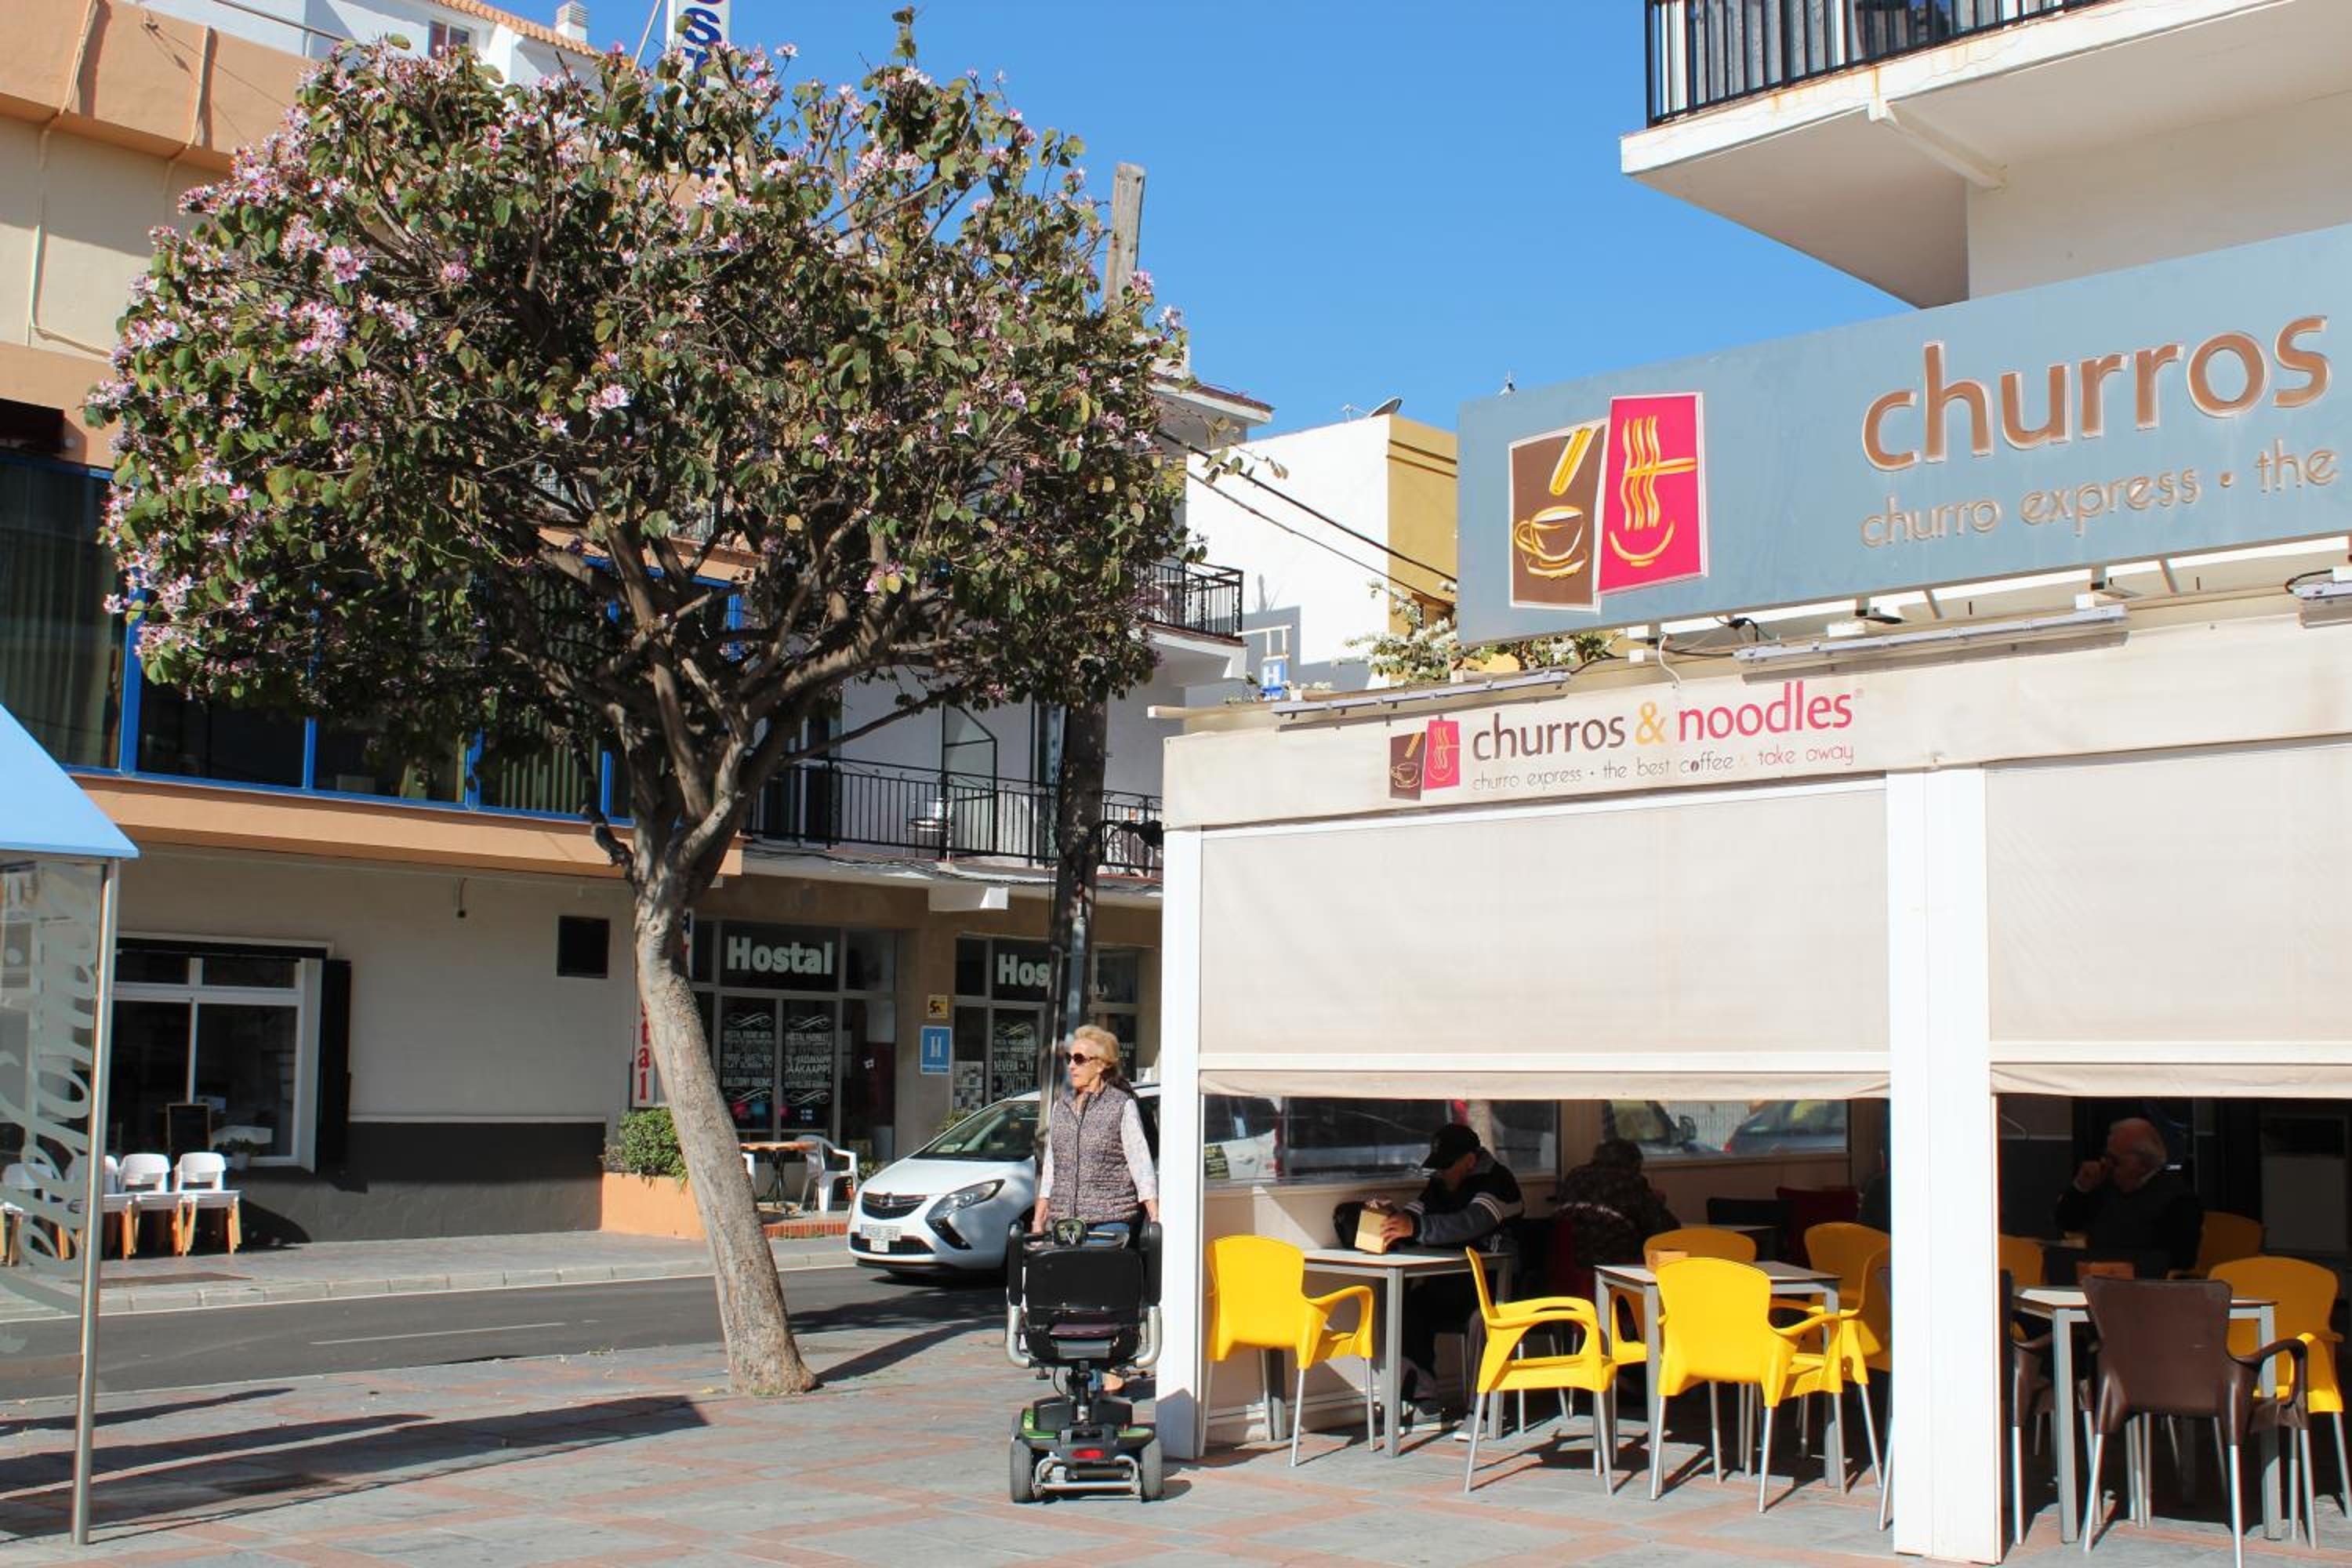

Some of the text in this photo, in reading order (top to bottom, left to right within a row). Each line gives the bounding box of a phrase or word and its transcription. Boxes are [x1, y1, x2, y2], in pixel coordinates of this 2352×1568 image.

[1862, 315, 2331, 471] churros
[1860, 438, 2338, 547] churro express the
[1472, 680, 1853, 761] churros & noodles
[1473, 771, 1519, 791] churro
[1526, 768, 1581, 791] express
[1603, 758, 1628, 779] the
[1637, 756, 1670, 776] best
[1680, 750, 1734, 774] coffee
[1757, 743, 1796, 767] take
[1805, 746, 1854, 766] away
[727, 935, 833, 975] Hostal
[998, 953, 1049, 987] Hos
